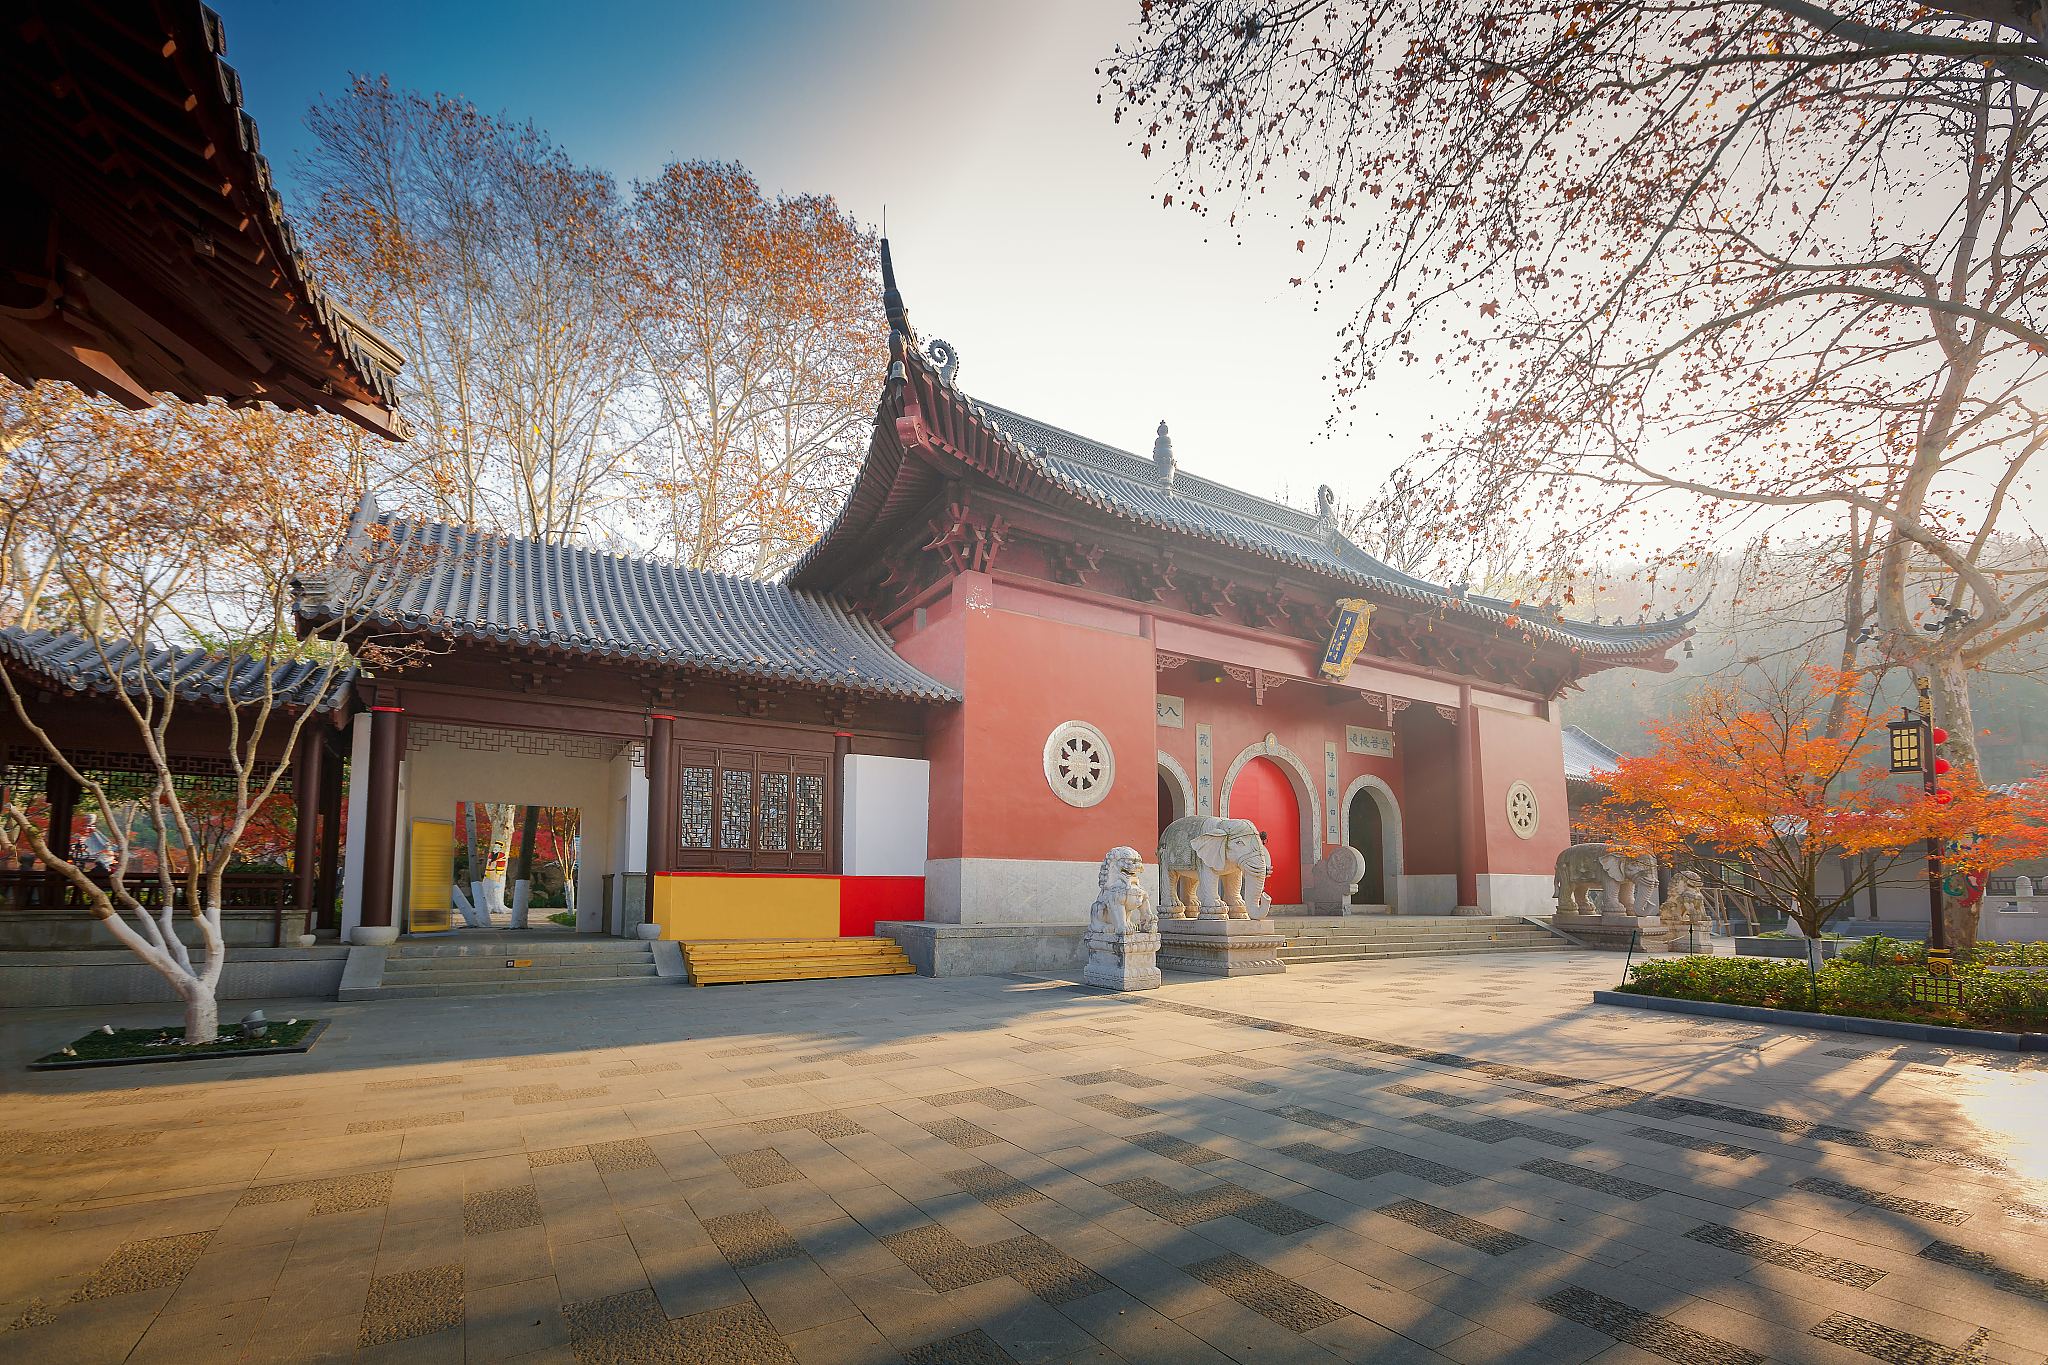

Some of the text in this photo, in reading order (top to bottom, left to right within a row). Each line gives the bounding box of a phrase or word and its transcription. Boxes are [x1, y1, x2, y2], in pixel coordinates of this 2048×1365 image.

[1914, 978, 1959, 988] 文明旅游
[1914, 985, 1960, 996] 请勿踩踏
[1915, 993, 1960, 1004] 谢谢配合
